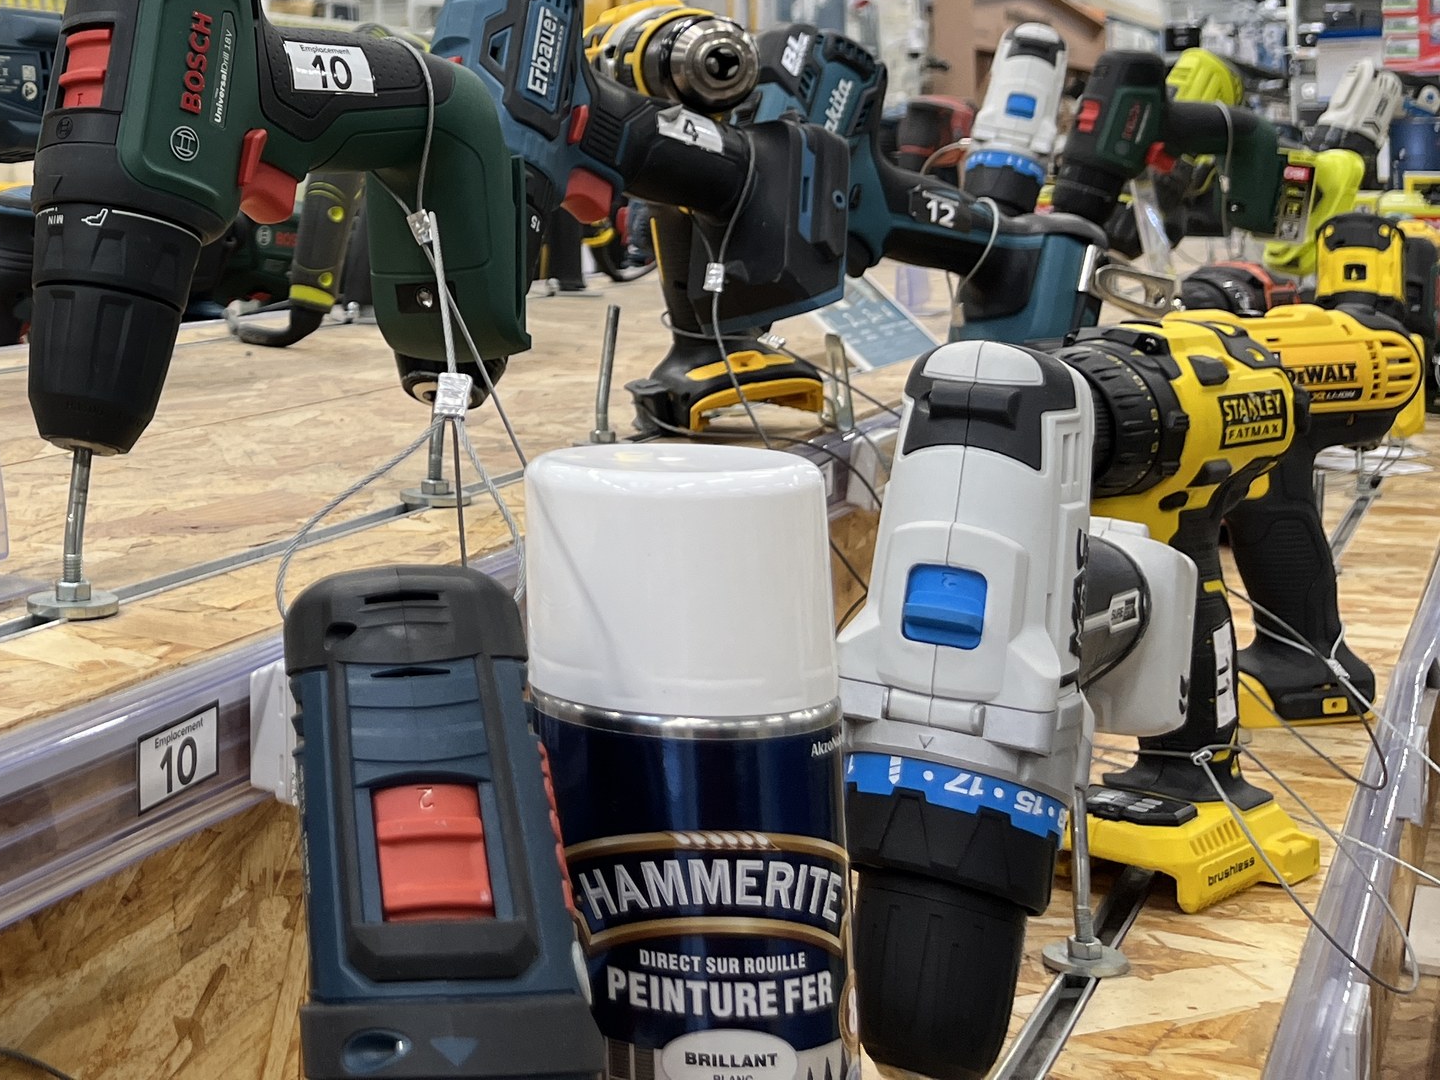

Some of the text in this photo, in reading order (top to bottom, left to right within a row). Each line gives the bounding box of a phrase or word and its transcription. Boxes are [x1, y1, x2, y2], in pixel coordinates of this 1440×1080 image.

[179, 11, 214, 115] BOSCH
[299, 44, 351, 55] Emplacement
[527, 6, 558, 96] Erbauer
[214, 53, 230, 124] UniversalDrill
[224, 28, 234, 52] 18V
[312, 54, 353, 90] 10
[824, 78, 853, 136] akita
[684, 119, 699, 141] 4
[48, 214, 64, 225] MIN
[530, 215, 541, 232] 15
[926, 200, 956, 228] 12
[1222, 393, 1282, 422] STANLEY
[1228, 424, 1279, 440] FATMAX
[154, 717, 204, 749] Emplacement
[159, 736, 197, 794] 10
[944, 773, 985, 796] 17
[1014, 790, 1044, 816] 15
[1208, 856, 1255, 886] brushless
[578, 859, 843, 923] HAMMERITE
[639, 949, 806, 975] DIRECT SUR ROUILLE
[607, 966, 834, 1018] PEINTURE FER
[684, 1051, 778, 1068] BRILLANT
